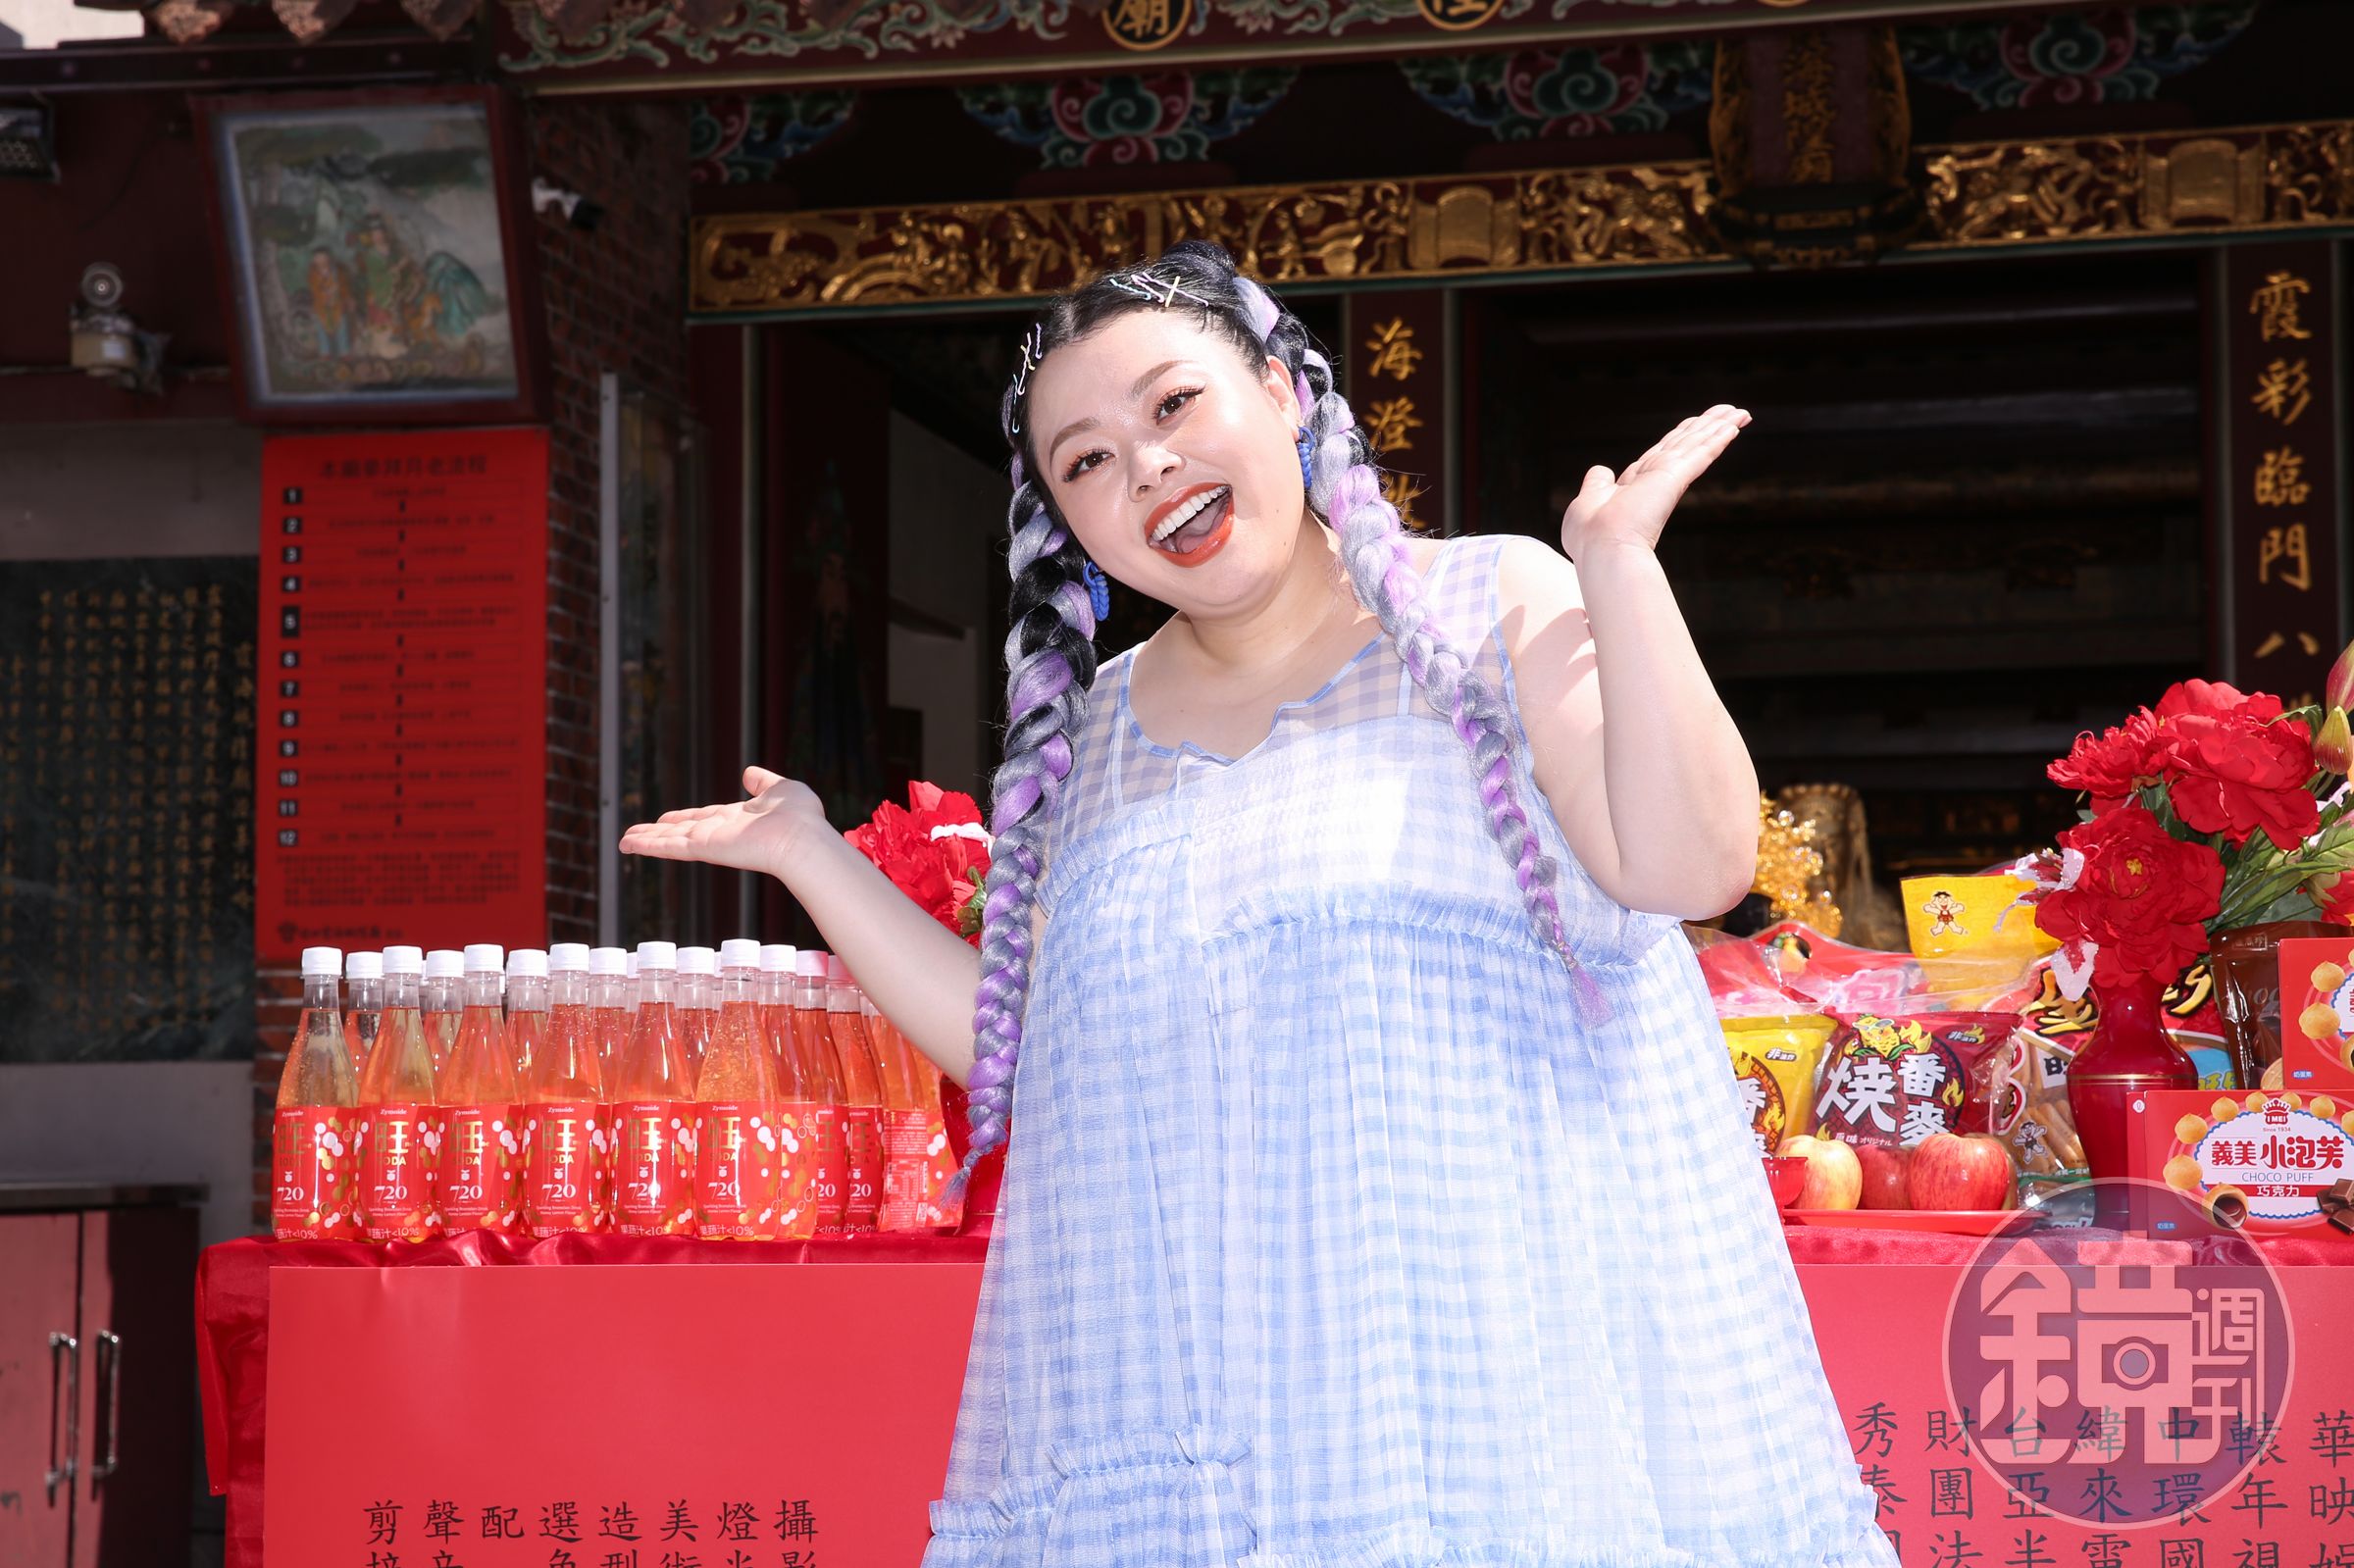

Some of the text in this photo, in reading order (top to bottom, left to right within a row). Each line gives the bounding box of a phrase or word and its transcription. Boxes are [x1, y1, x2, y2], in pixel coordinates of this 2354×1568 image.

[2249, 271, 2320, 720] 霞彩臨門八
[2211, 1135, 2345, 1170] 義美 小泡芙
[2241, 1172, 2314, 1183] CHOCO PUFF
[277, 1187, 305, 1202] 720
[374, 1186, 408, 1202] 720
[449, 1186, 484, 1201] 720
[541, 1184, 577, 1200] 720
[628, 1182, 662, 1199] 720
[708, 1182, 741, 1199] 720
[818, 1183, 836, 1196] 20
[850, 1183, 872, 1196] 20
[2256, 1186, 2301, 1197] 巧克力
